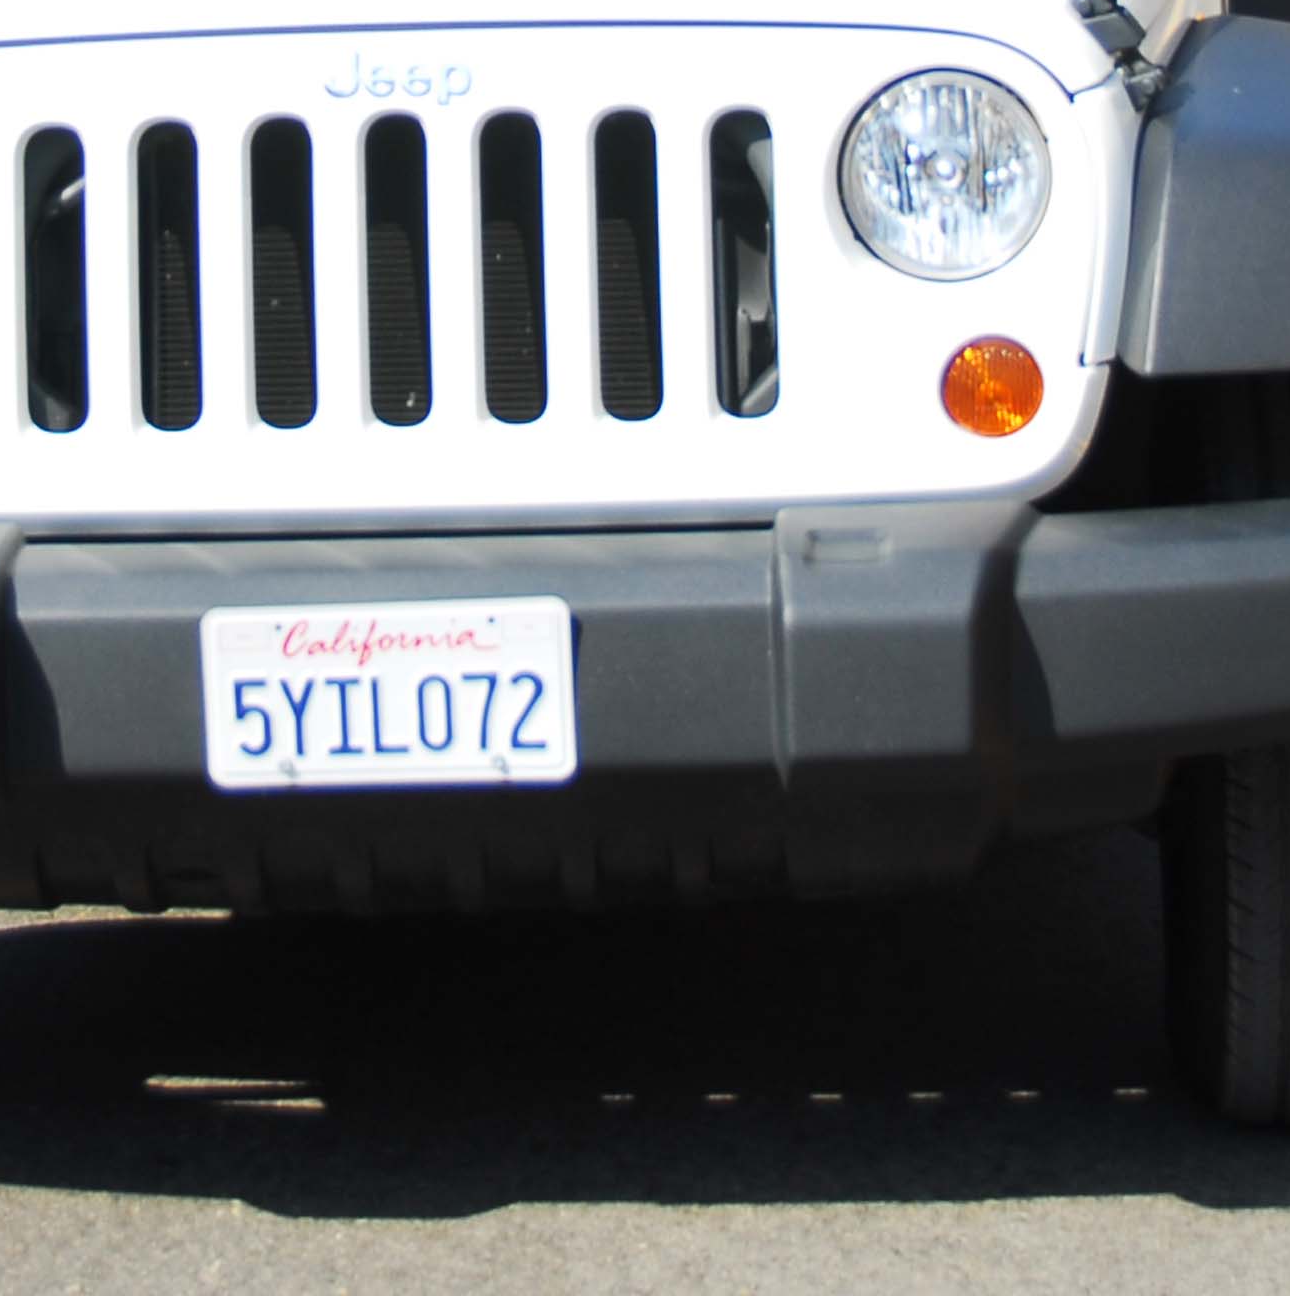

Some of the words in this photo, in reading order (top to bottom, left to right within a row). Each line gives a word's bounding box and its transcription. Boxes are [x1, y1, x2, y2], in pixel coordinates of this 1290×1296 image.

[324, 51, 473, 106] Jeep
[282, 618, 500, 666] California
[234, 671, 547, 757] 5YIL072
